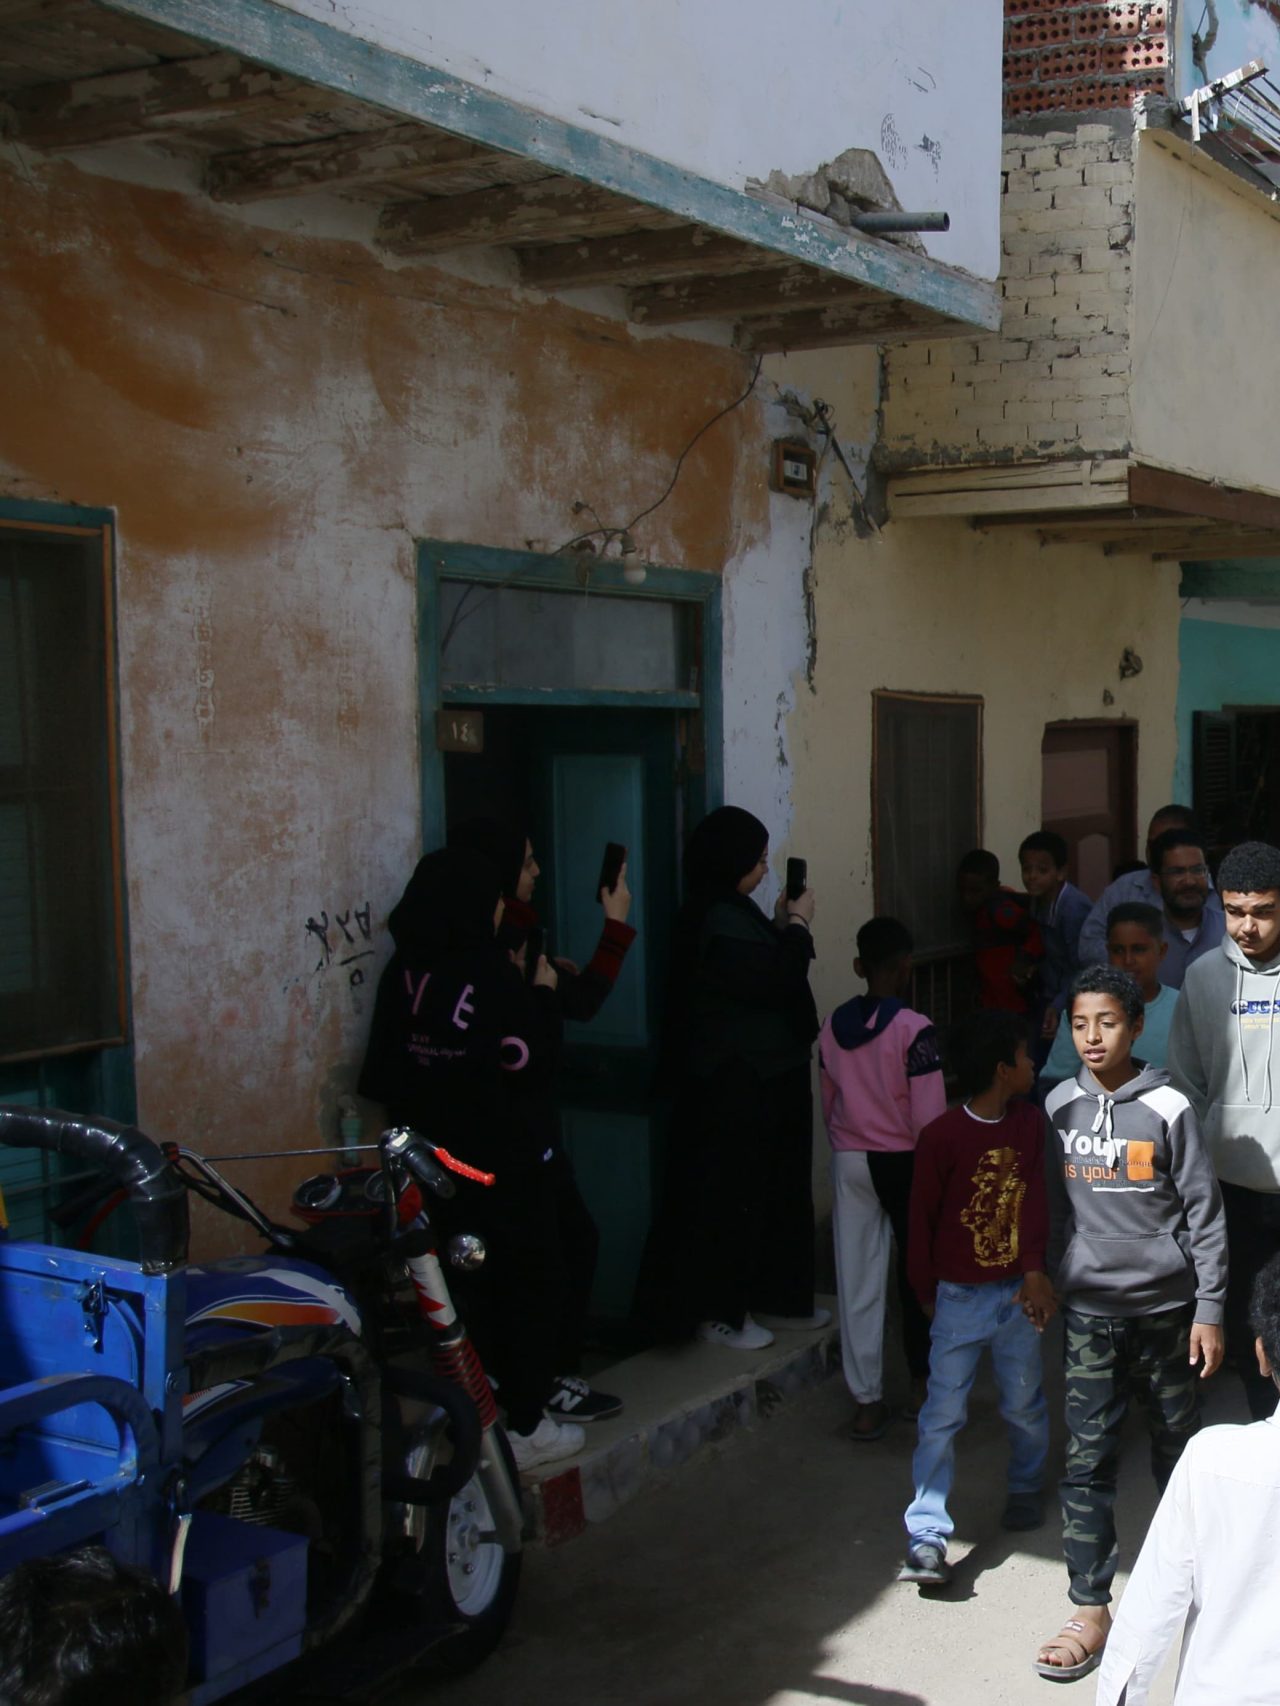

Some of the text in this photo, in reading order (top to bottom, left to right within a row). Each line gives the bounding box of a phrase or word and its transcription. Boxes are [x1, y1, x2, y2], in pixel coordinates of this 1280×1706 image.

[1057, 1129, 1128, 1158] Your
[1064, 1160, 1078, 1179] is
[1082, 1164, 1120, 1183] your
